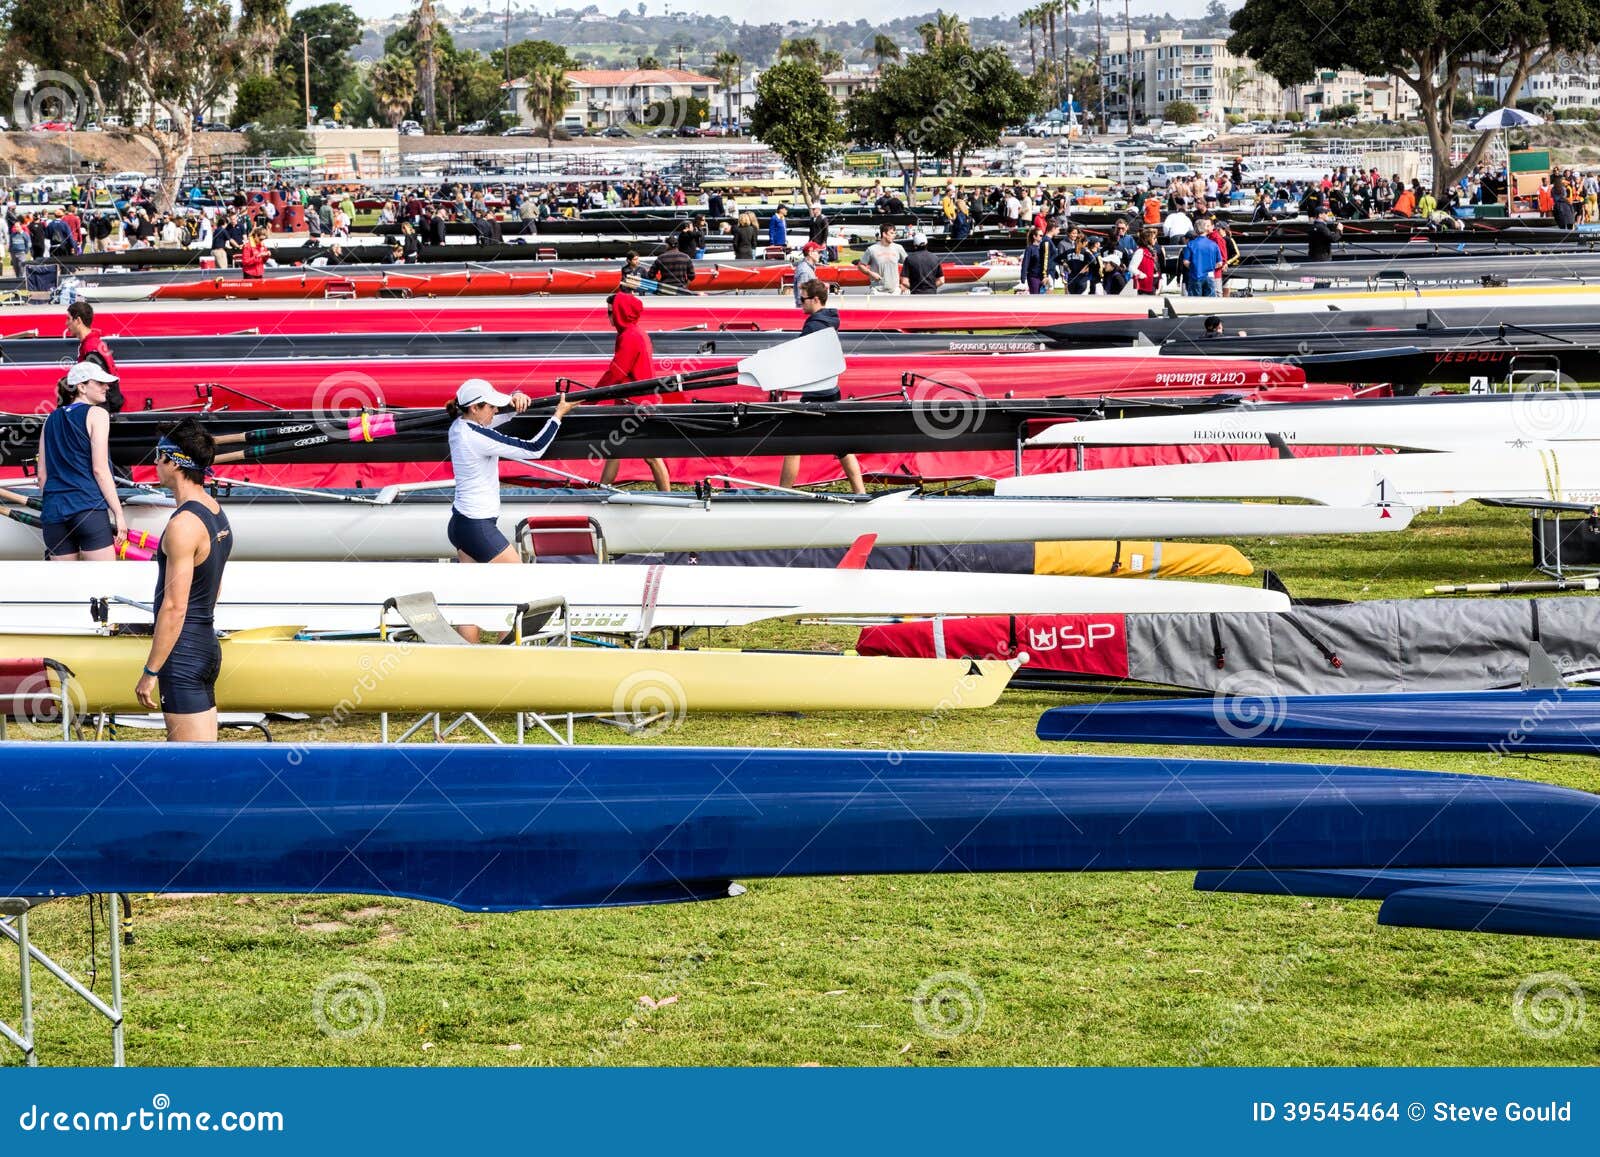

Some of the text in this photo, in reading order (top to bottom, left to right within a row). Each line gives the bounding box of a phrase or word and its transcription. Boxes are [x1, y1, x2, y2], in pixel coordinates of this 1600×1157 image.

[1434, 351, 1505, 363] VESPOLI
[1154, 372, 1246, 387] Carte Blanche
[1471, 378, 1485, 395] 4
[279, 424, 313, 434] CROKER
[294, 435, 328, 447] CROKER
[1376, 478, 1385, 501] 1
[1029, 623, 1115, 651] USP
